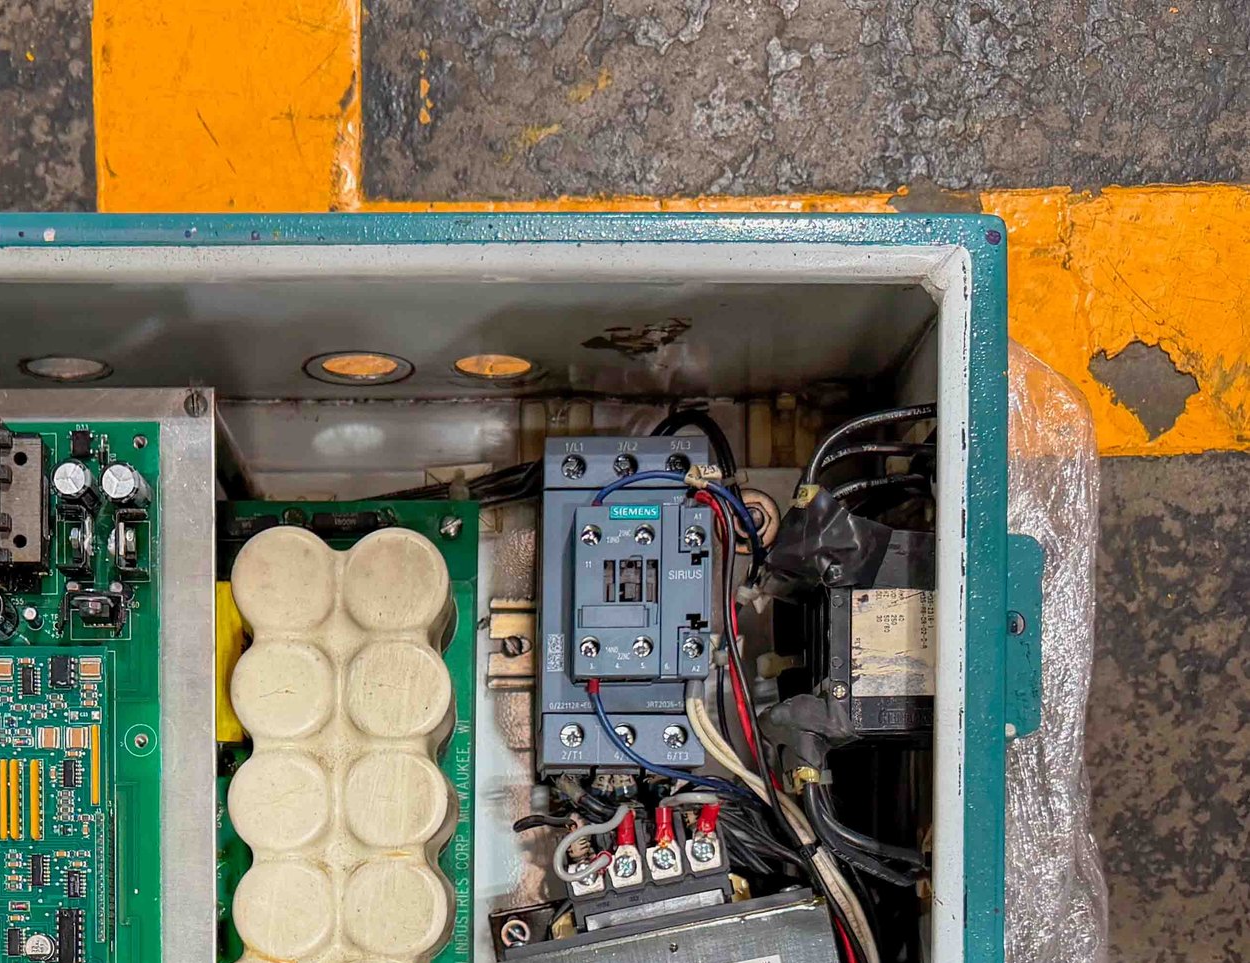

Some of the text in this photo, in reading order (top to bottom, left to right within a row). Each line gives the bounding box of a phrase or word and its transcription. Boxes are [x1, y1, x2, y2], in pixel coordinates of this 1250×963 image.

[564, 442, 584, 453] 1/L1
[617, 441, 638, 451] 3/L2
[670, 440, 691, 450] 5/L3
[612, 506, 658, 516] SIEMENS
[668, 569, 703, 581] SIRIUS
[456, 719, 470, 734] WI
[561, 750, 583, 760] 2/T1
[666, 750, 689, 761] 6/T3
[455, 878, 469, 955] INDUSTRIES
